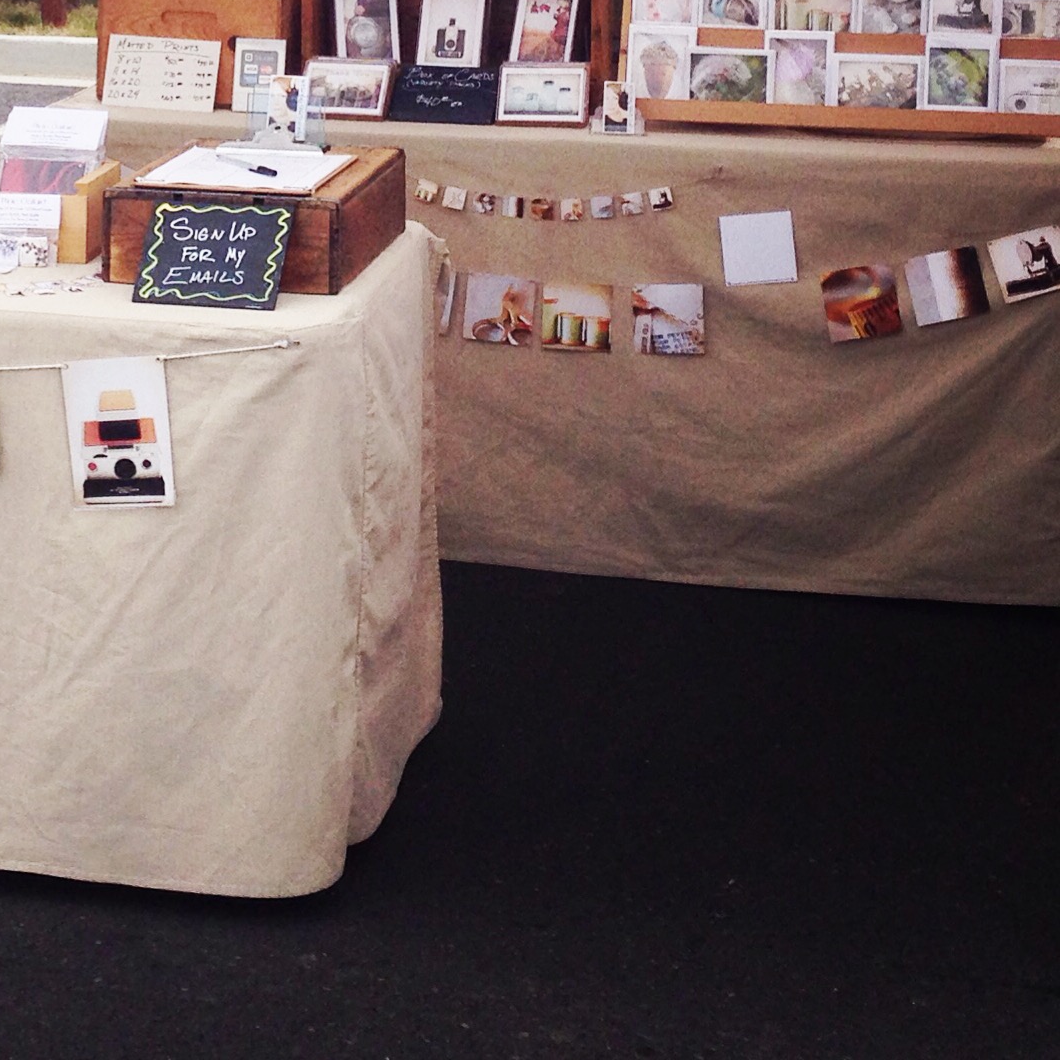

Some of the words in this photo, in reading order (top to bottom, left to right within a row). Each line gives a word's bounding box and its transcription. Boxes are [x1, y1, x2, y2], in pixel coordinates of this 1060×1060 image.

[170, 217, 225, 241] SIGN
[229, 221, 256, 242] UP
[181, 246, 215, 262] FOR
[162, 266, 245, 285] EMAILS
